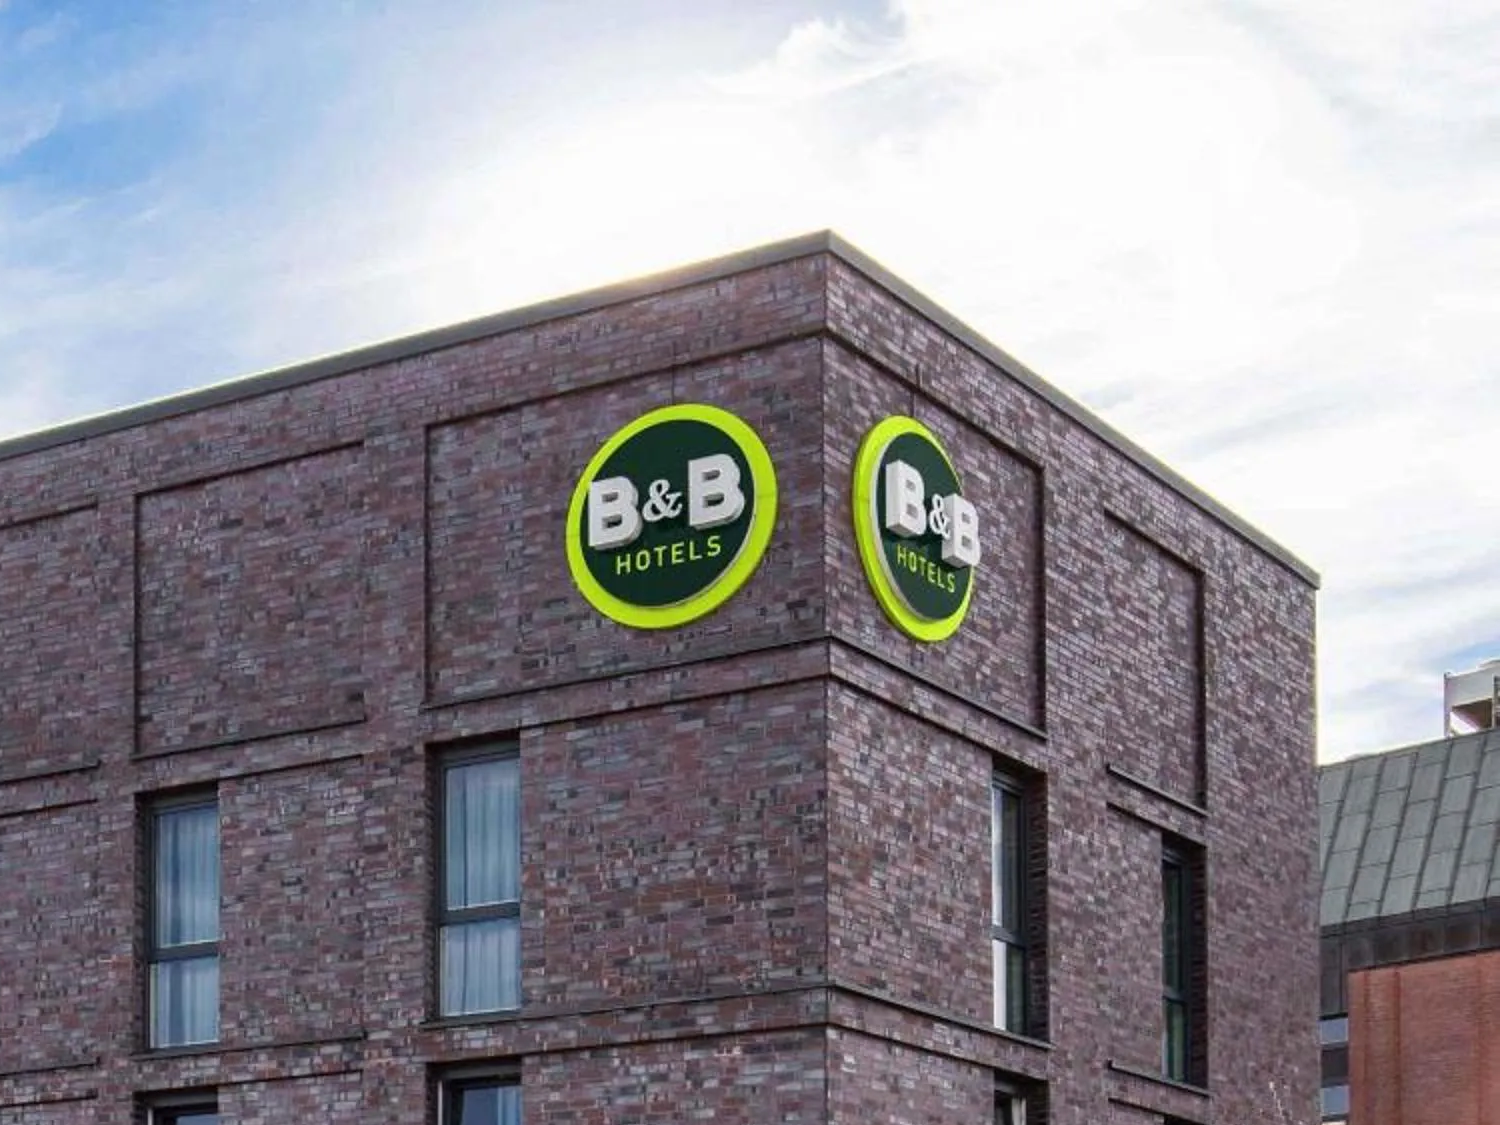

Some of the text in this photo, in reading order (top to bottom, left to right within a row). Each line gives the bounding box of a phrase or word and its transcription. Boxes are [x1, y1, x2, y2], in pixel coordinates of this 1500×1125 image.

[588, 453, 746, 550] B&B
[885, 459, 981, 568] B&B
[615, 535, 722, 575] HOTELS
[897, 543, 956, 593] HOTELS
